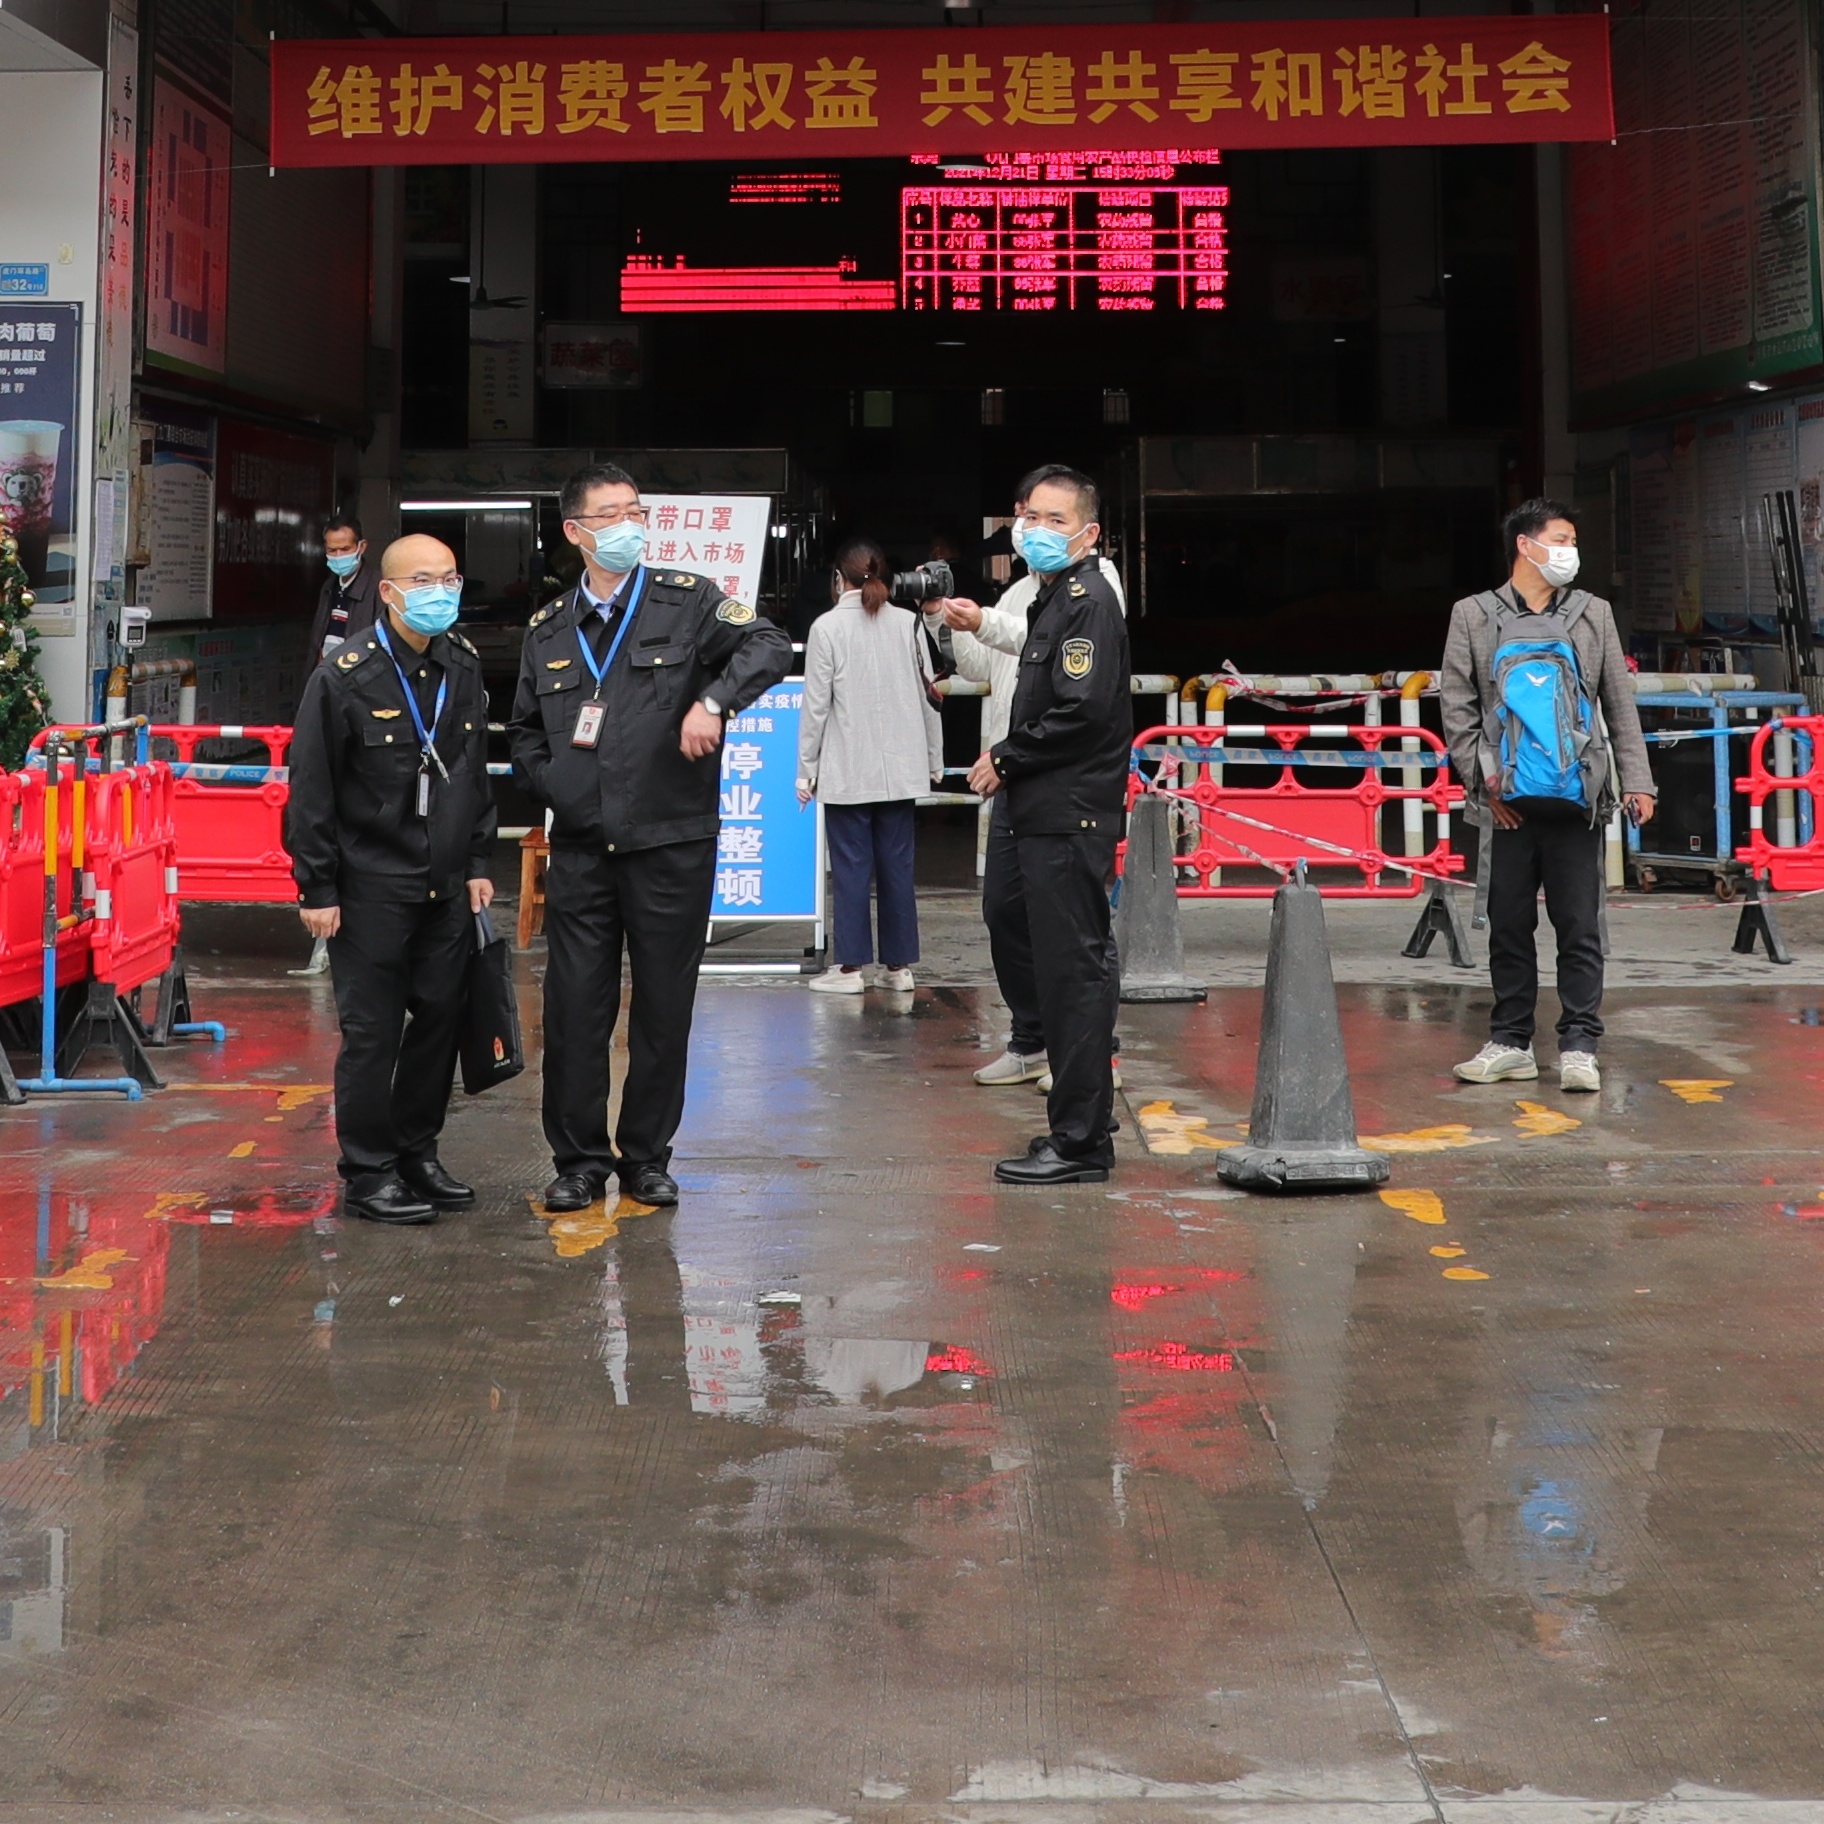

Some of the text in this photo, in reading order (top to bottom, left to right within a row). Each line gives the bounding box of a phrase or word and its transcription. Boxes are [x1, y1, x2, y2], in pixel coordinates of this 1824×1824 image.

[306, 41, 1574, 138] 维护消费者权益 共建共享和谐社会
[230, 768, 261, 778] POLICE
[717, 742, 764, 908] 停业整顿
